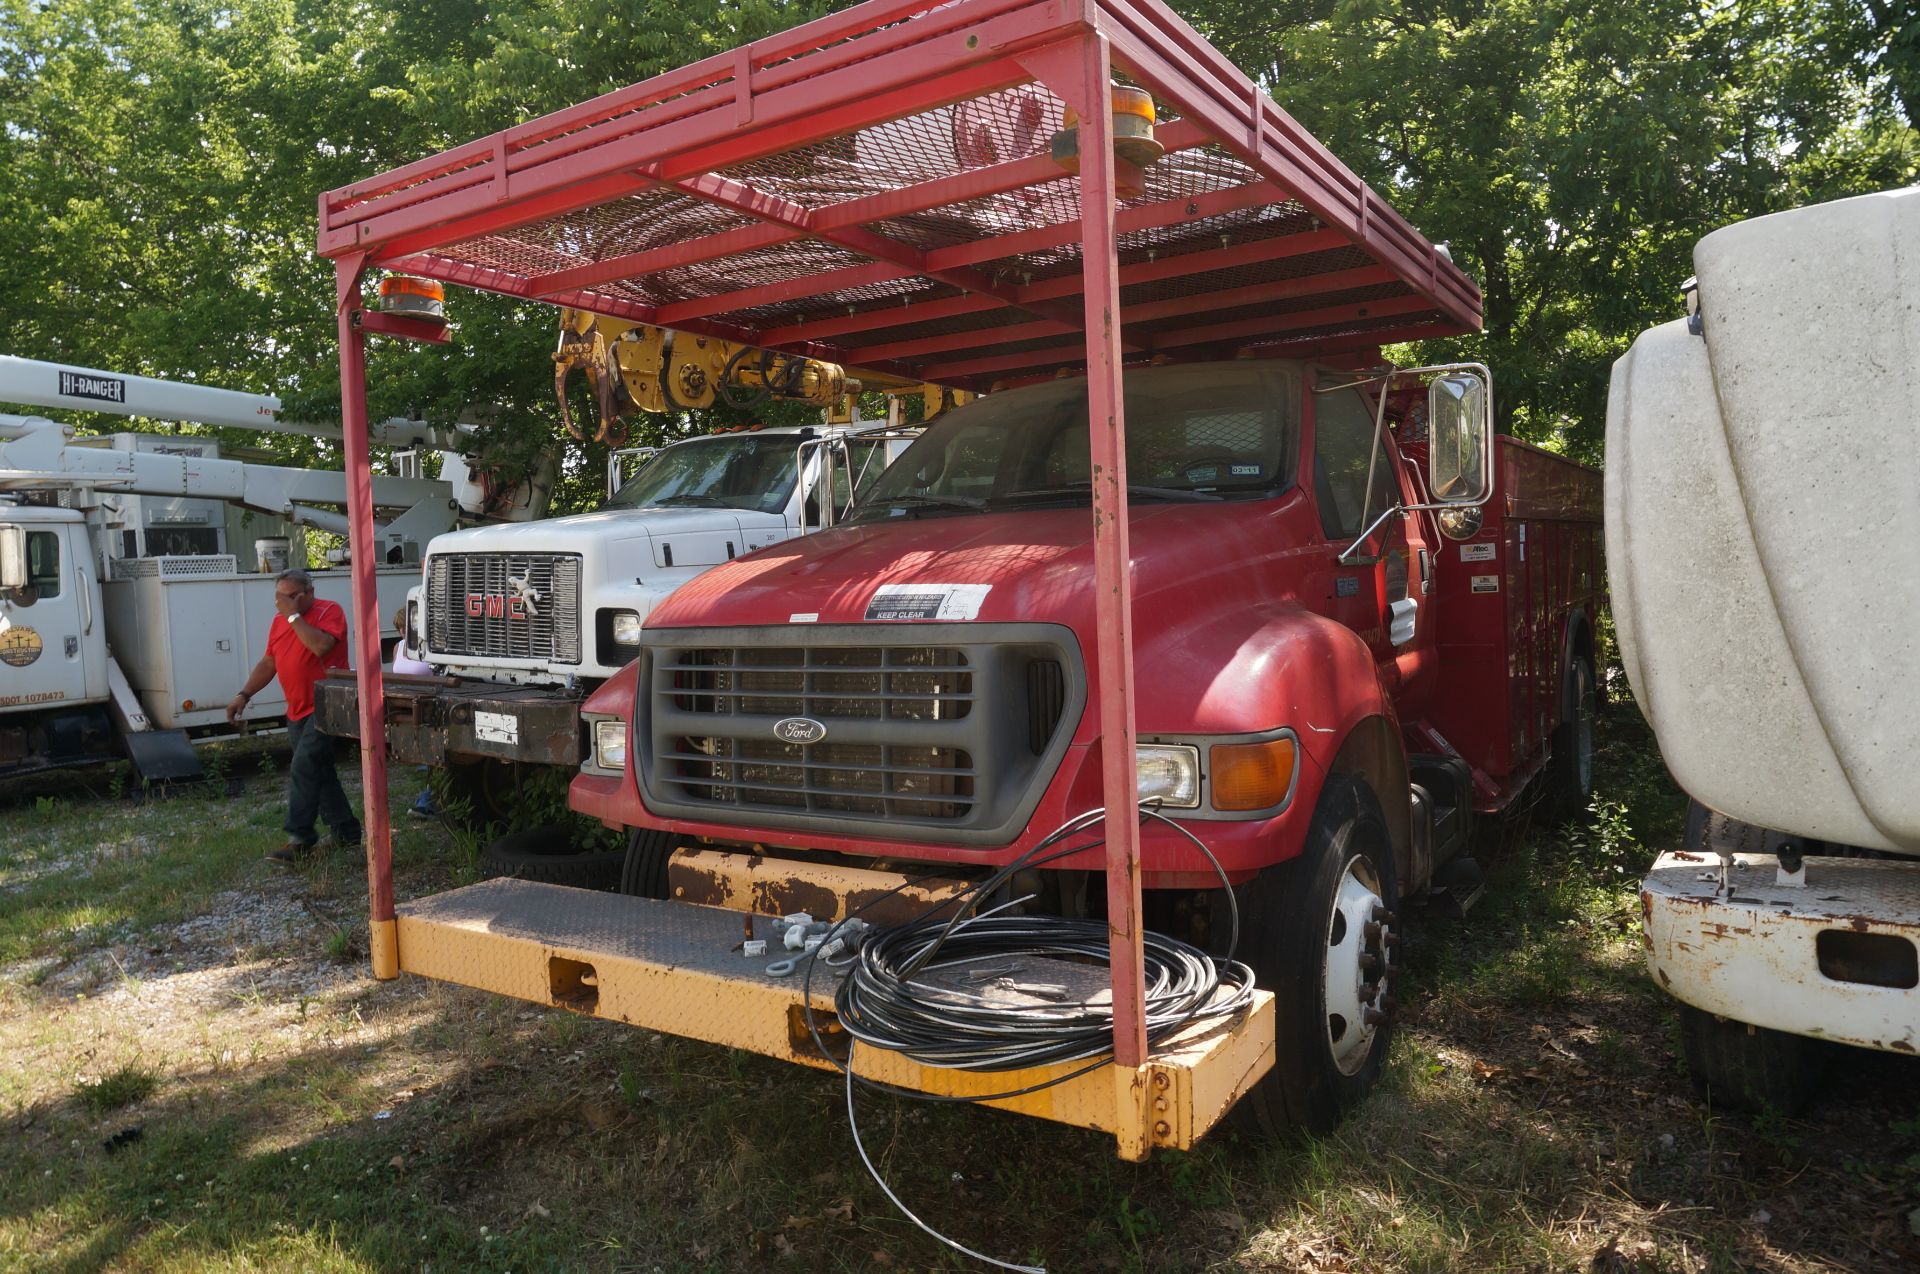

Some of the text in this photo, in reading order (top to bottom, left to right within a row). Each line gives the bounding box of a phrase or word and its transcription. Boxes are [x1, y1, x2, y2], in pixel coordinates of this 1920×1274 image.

[62, 372, 122, 401] HI-RANGER
[465, 593, 526, 620] GMC
[876, 611, 925, 619] KEEP CLEAR
[25, 691, 65, 702] 1078473
[785, 722, 814, 738] Ford
